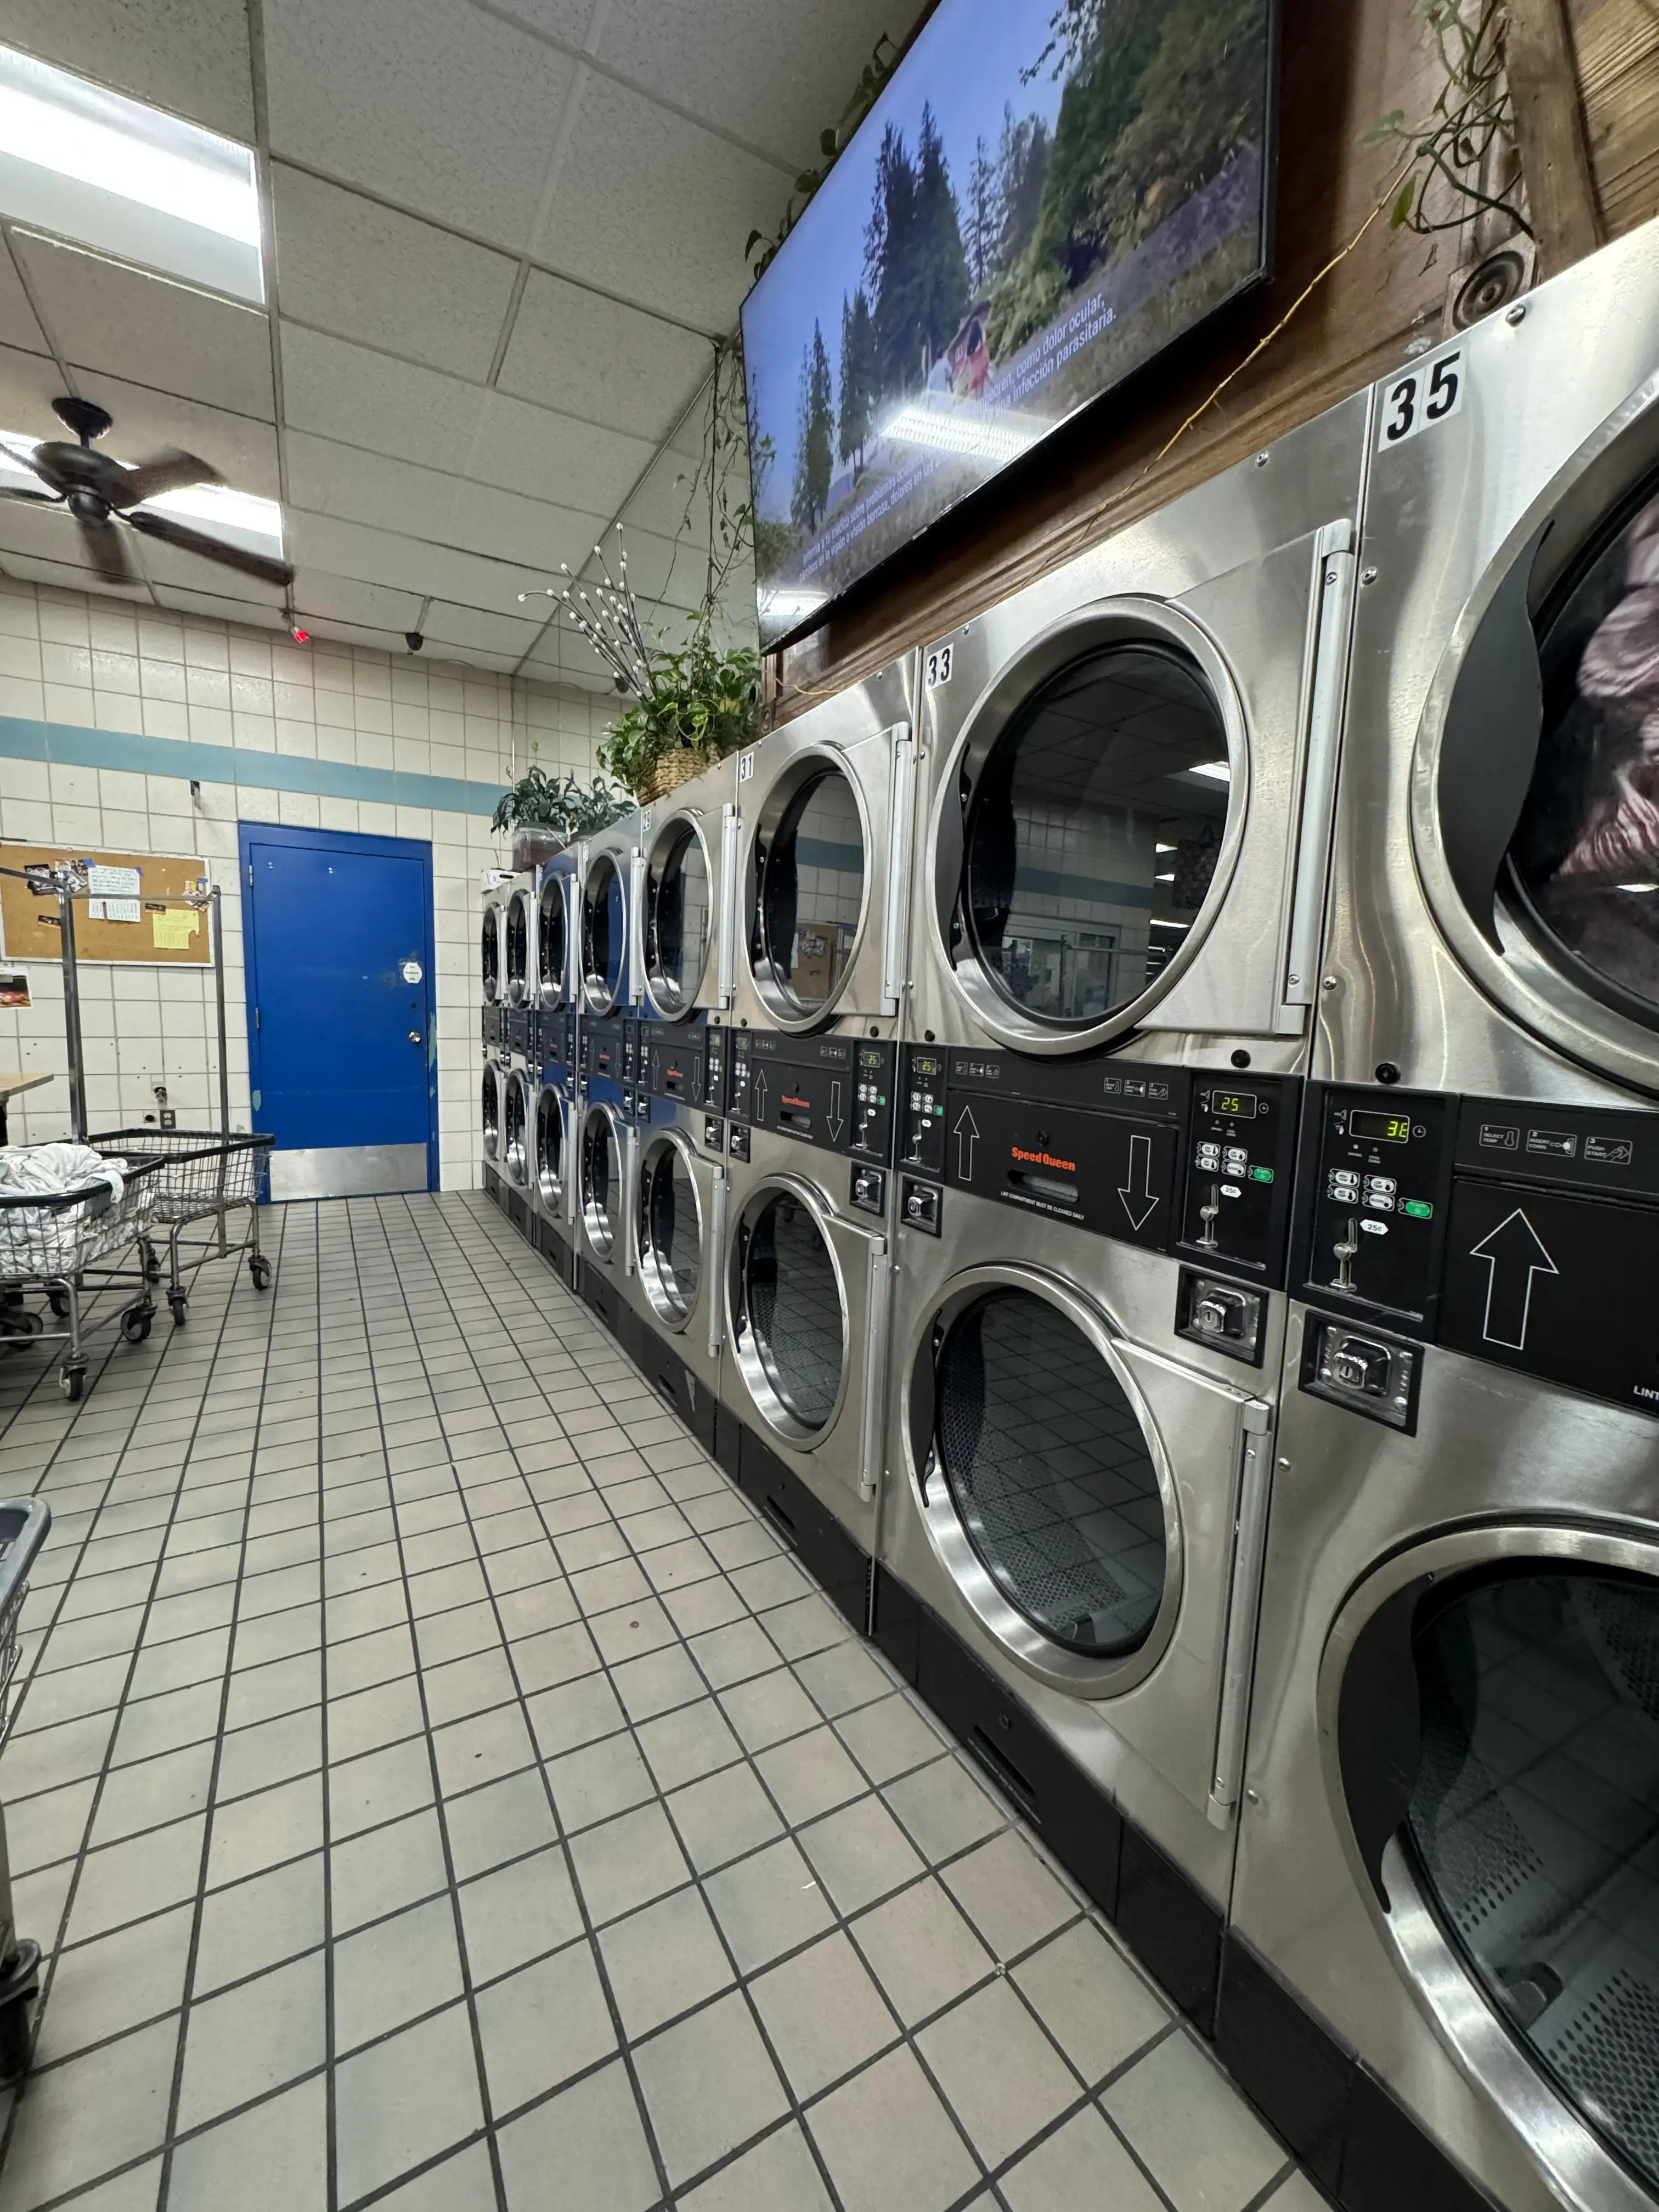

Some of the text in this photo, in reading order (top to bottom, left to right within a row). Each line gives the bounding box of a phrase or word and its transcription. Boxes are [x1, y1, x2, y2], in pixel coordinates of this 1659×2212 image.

[1016, 347, 1041, 379] como
[1042, 324, 1067, 357] dolor
[1069, 293, 1105, 332] ocular,
[891, 478, 913, 506] dolores
[913, 470, 922, 486] en
[1014, 357, 1054, 402] infección
[1057, 307, 1116, 370] parasitaria.
[1386, 350, 1461, 441] 35
[927, 648, 950, 687] 33
[741, 754, 752, 780] 31
[643, 811, 650, 830] 29
[922, 1061, 931, 1071] 25
[1221, 1097, 1239, 1111] 25
[1011, 1146, 1076, 1171] Speed Queen
[1367, 1223, 1383, 1232] 25¢
[1633, 1385, 1659, 1401] LINT
